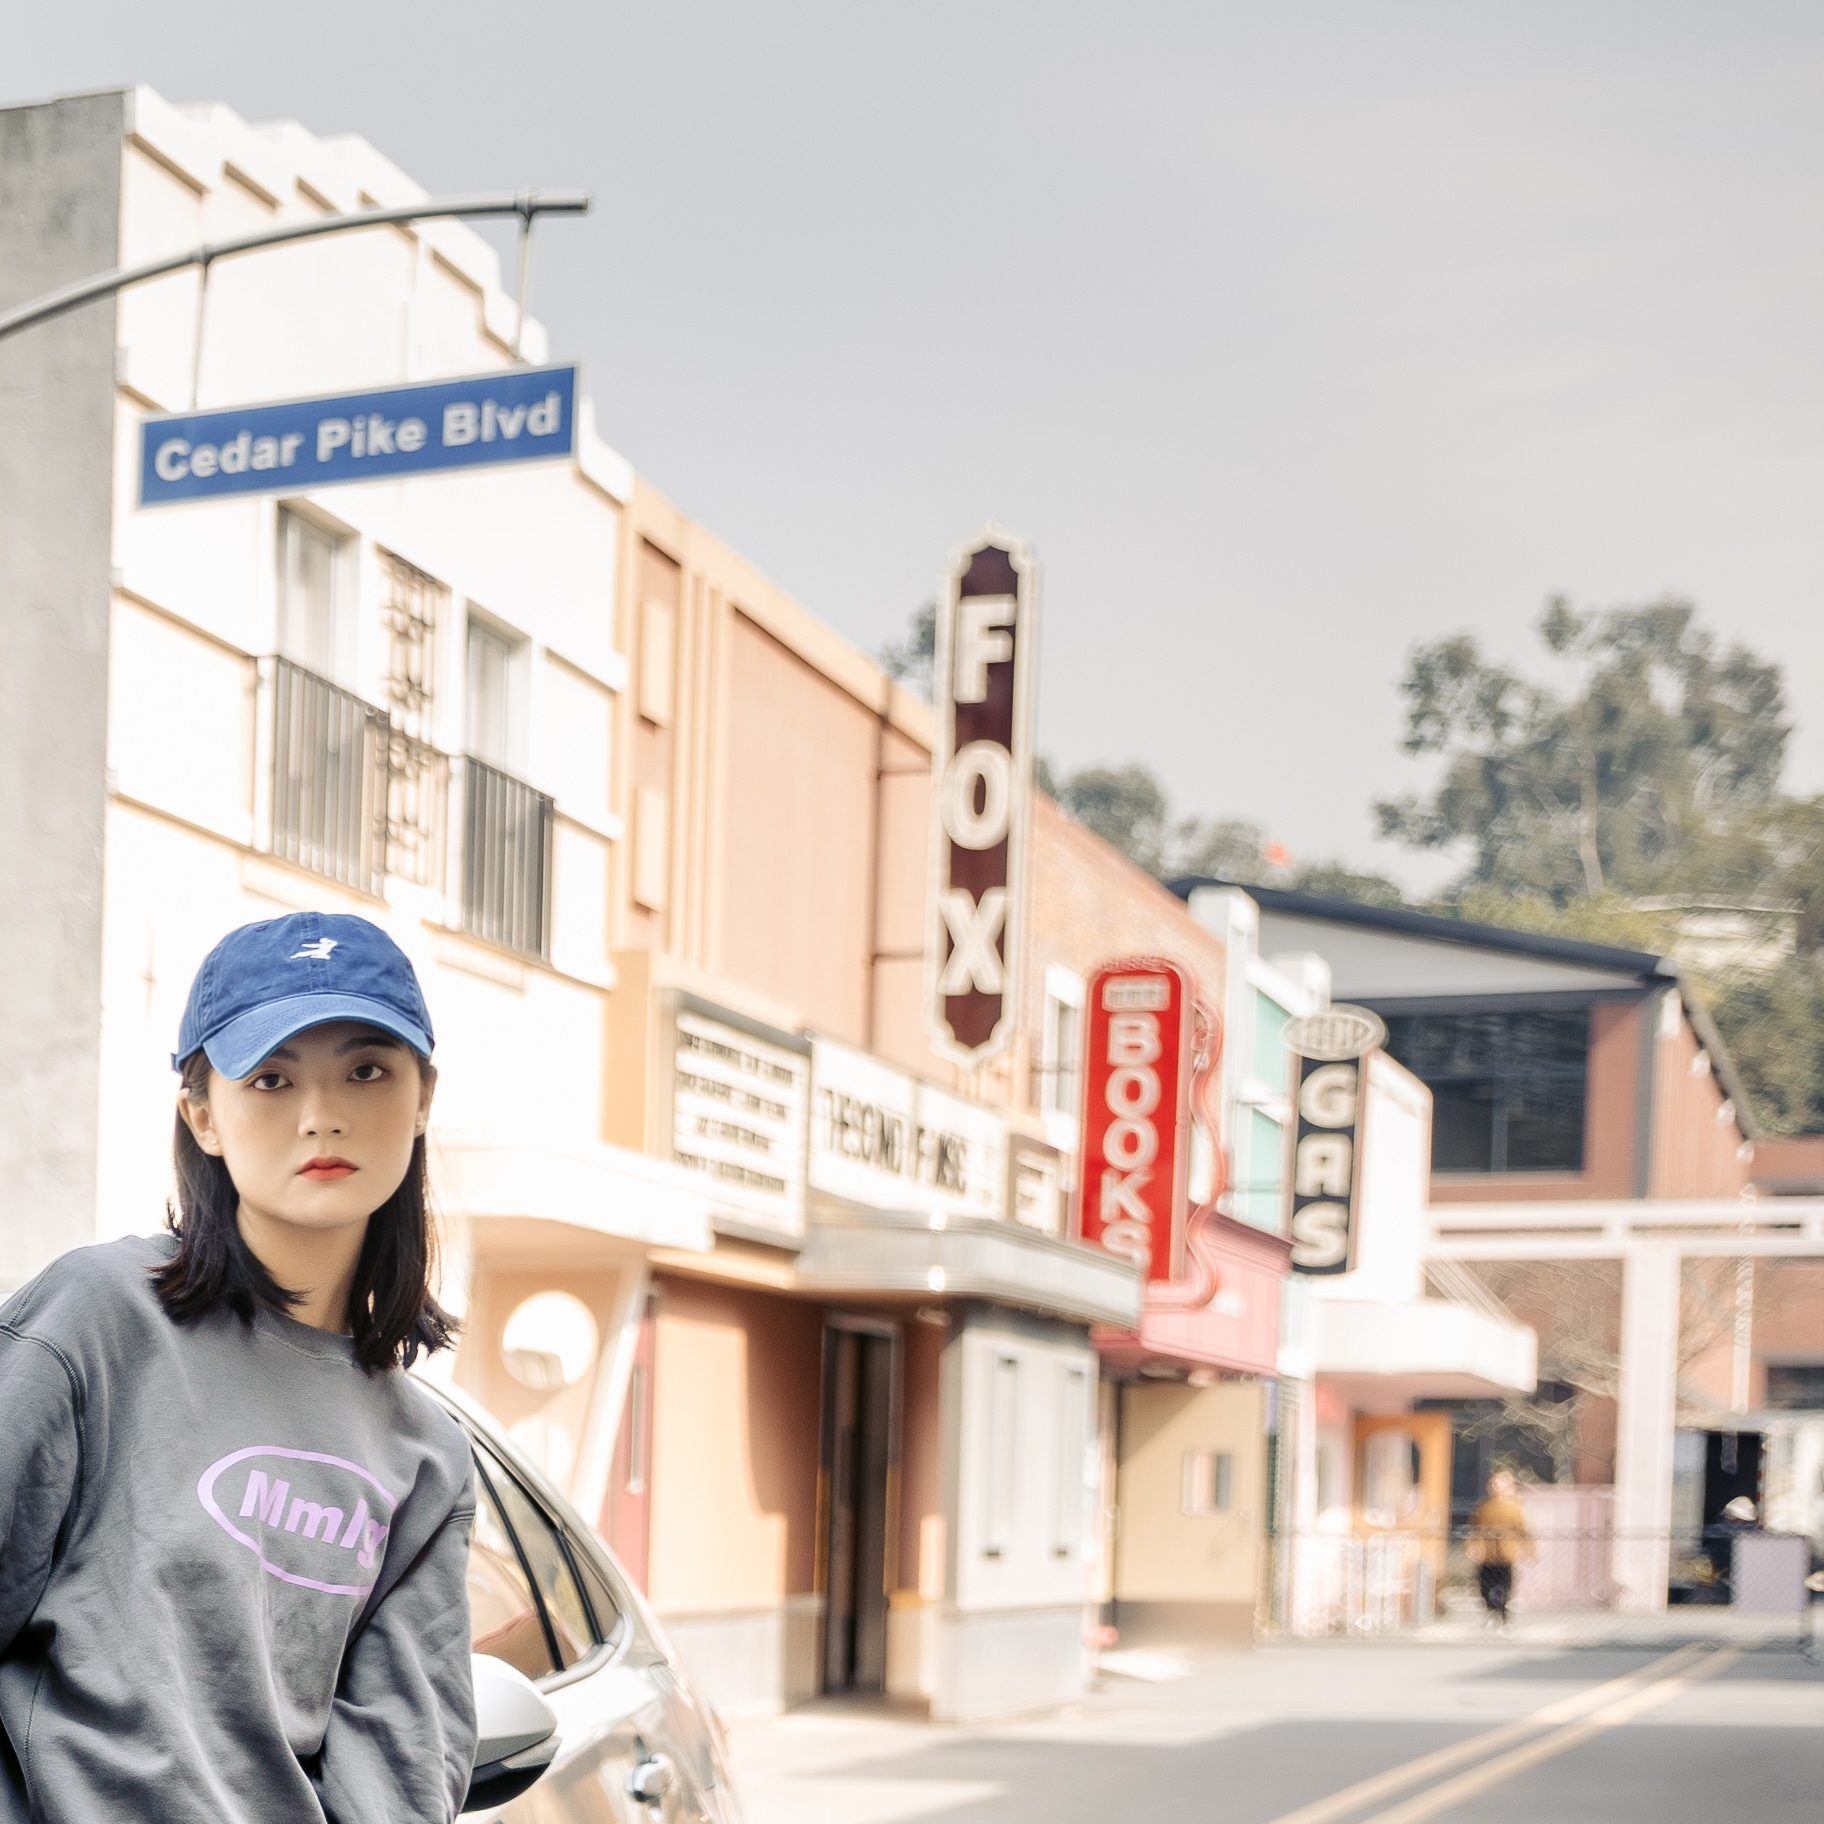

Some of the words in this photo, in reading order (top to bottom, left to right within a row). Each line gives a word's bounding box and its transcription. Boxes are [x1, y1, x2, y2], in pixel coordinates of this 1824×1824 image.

[154, 430, 305, 482] Cedar
[316, 413, 428, 462] Pike
[441, 391, 562, 448] Blvd
[938, 592, 1019, 998] FOX
[1099, 1011, 1164, 1274] BOOKS
[1290, 1062, 1358, 1268] GAS
